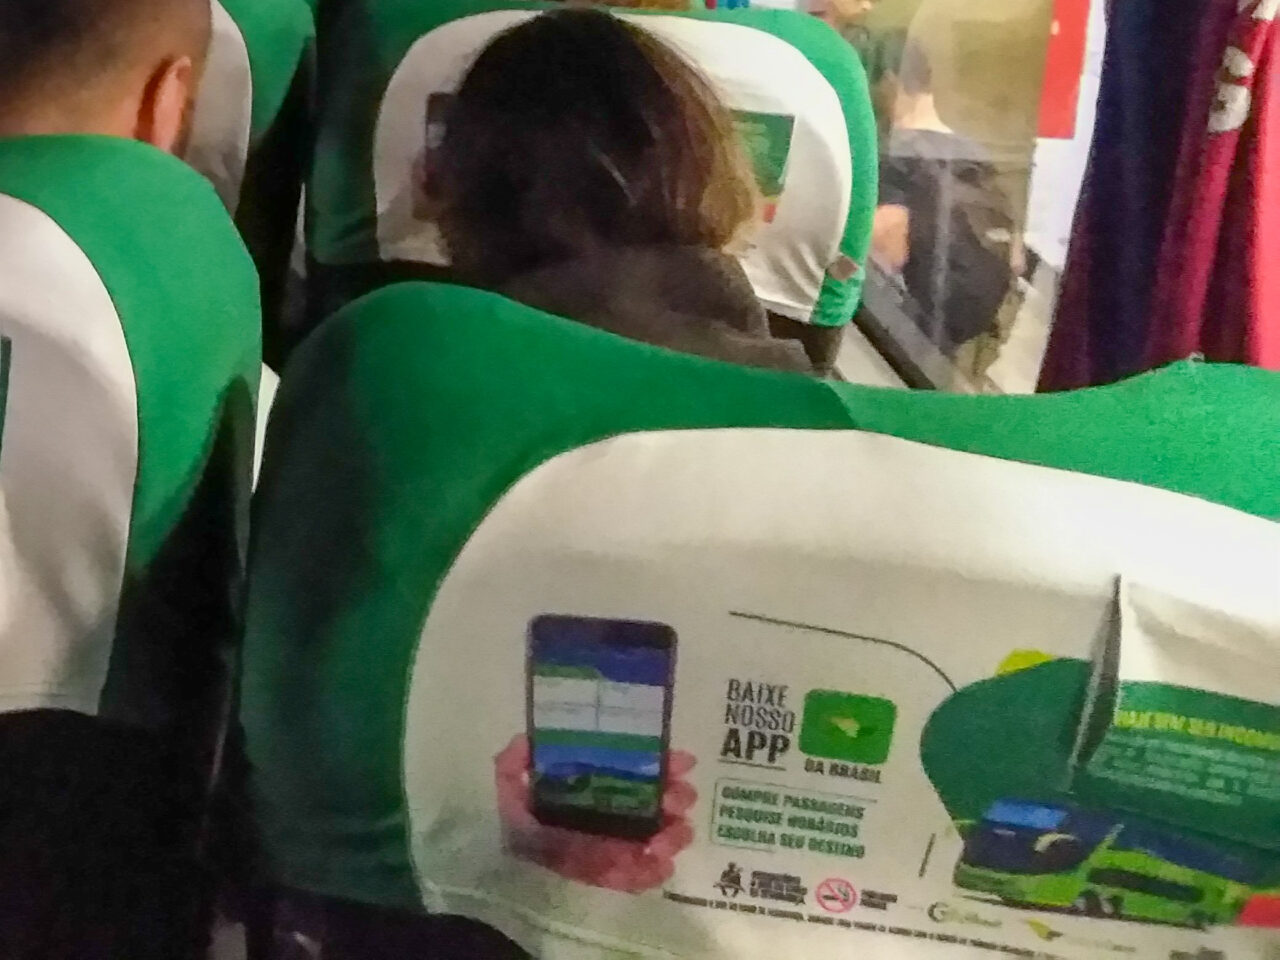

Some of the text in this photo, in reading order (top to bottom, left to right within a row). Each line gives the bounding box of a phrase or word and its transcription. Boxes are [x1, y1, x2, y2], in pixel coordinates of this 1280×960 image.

[728, 678, 789, 706] BAIXE
[725, 704, 795, 732] NOSSO
[721, 730, 790, 763] APP
